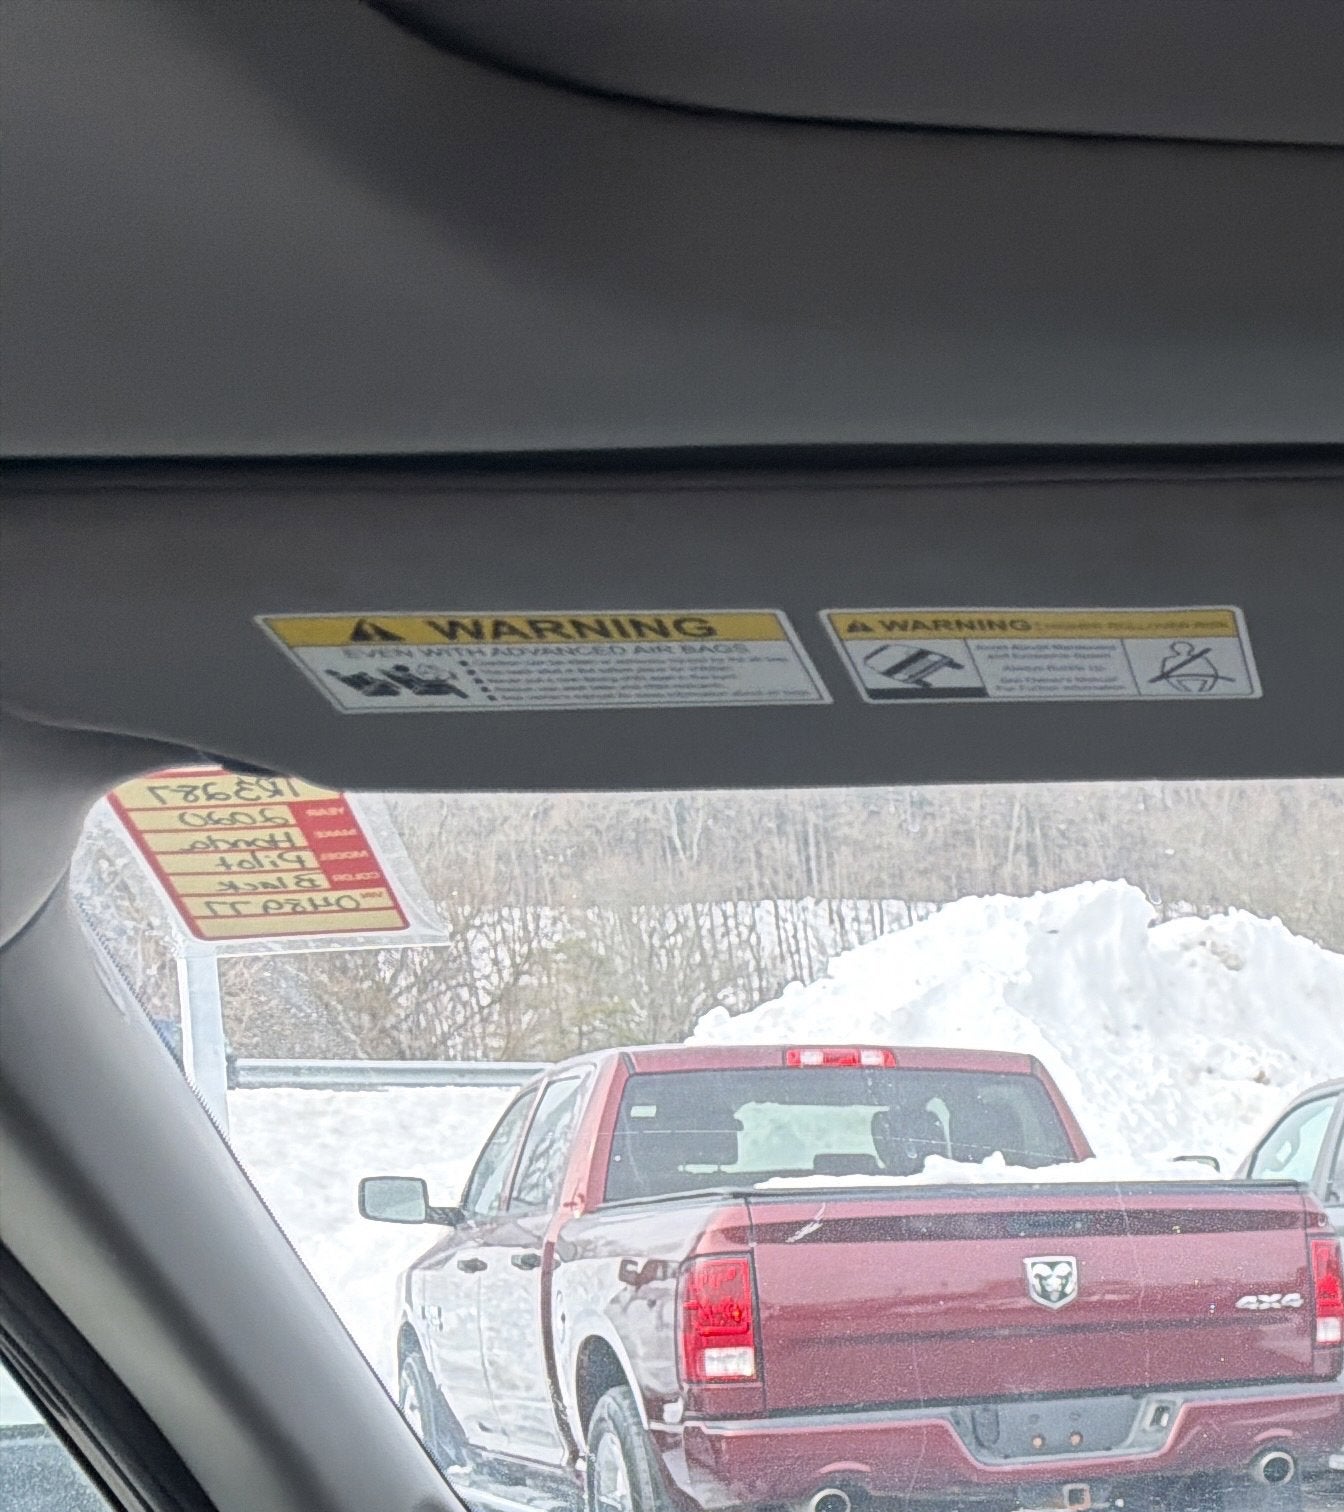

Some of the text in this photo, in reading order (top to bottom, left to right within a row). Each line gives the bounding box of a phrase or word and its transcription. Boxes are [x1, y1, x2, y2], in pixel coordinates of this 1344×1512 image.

[423, 617, 718, 640] WARNING
[342, 644, 749, 658] EVEN WITH ADVANCED AIR BAGS
